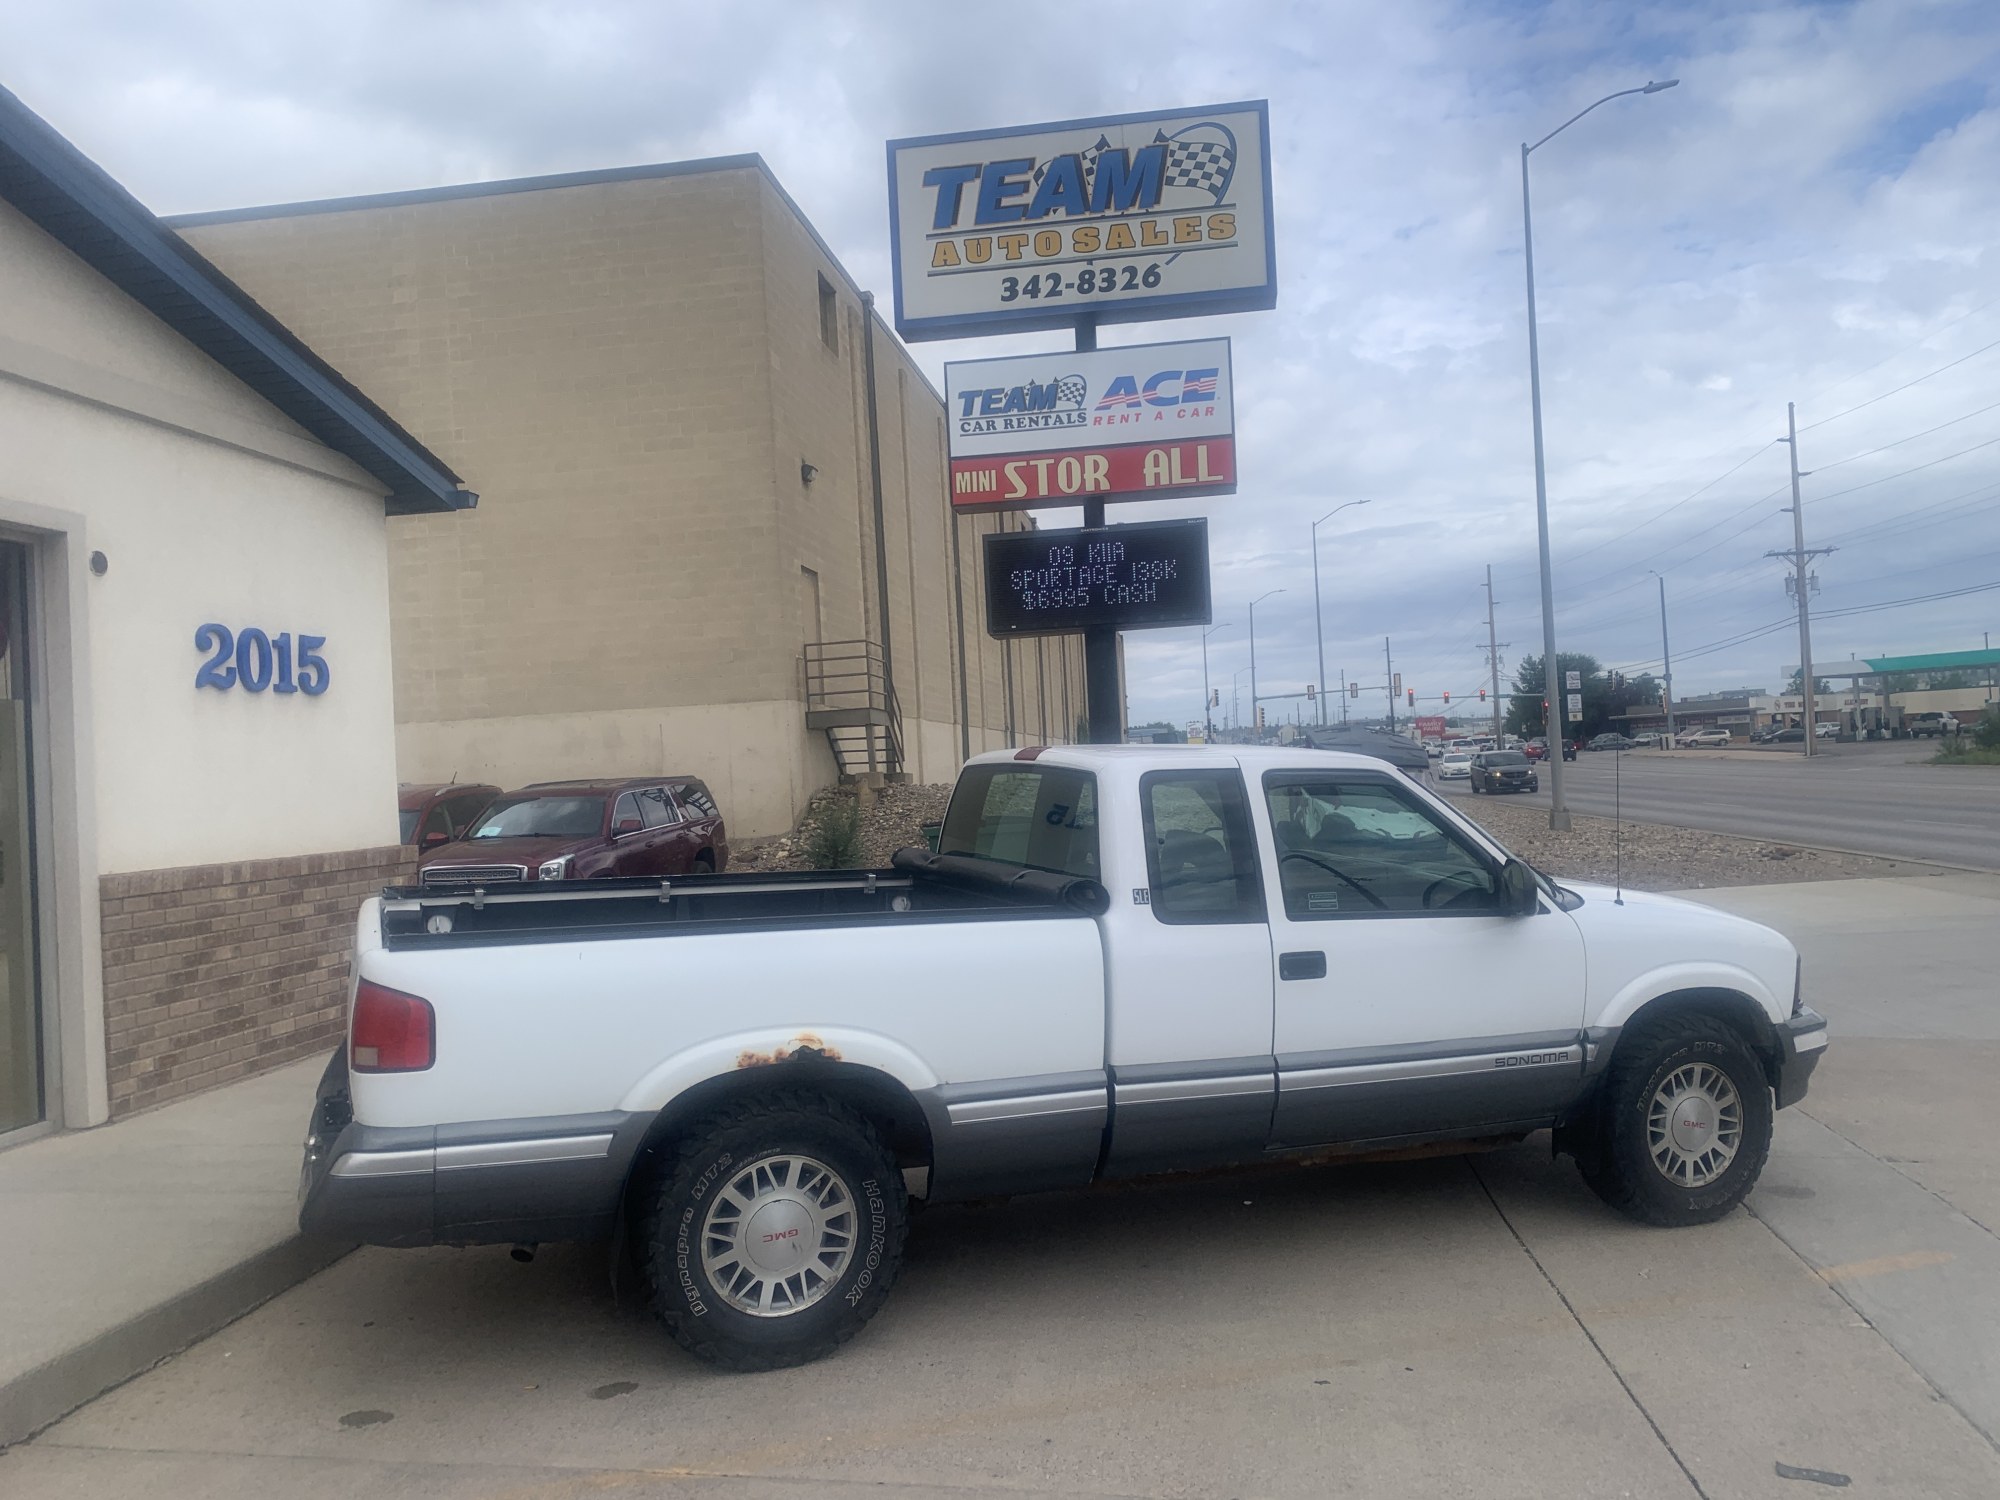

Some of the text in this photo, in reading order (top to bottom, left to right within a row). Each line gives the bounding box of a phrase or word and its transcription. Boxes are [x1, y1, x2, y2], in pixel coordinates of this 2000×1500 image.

[922, 144, 1169, 230] TEAM
[1000, 262, 1161, 301] 342-8326
[958, 383, 1059, 417] TEAM
[1094, 368, 1220, 411] ACE
[960, 412, 1087, 433] CAR RENTALS
[1093, 406, 1215, 426] RENT A CAR
[955, 445, 1223, 499] MINI STOR ALL
[1049, 545, 1074, 566] 09
[1011, 559, 1177, 590] SPORTAGE 138K
[1022, 582, 1156, 610] $6995 CASH
[195, 623, 330, 696] 2015
[1133, 889, 1149, 905] SLE
[1494, 1051, 1569, 1069] SONOMA
[1683, 1120, 1706, 1129] GMC
[691, 1152, 733, 1200] MT2
[763, 1228, 798, 1243] GMC
